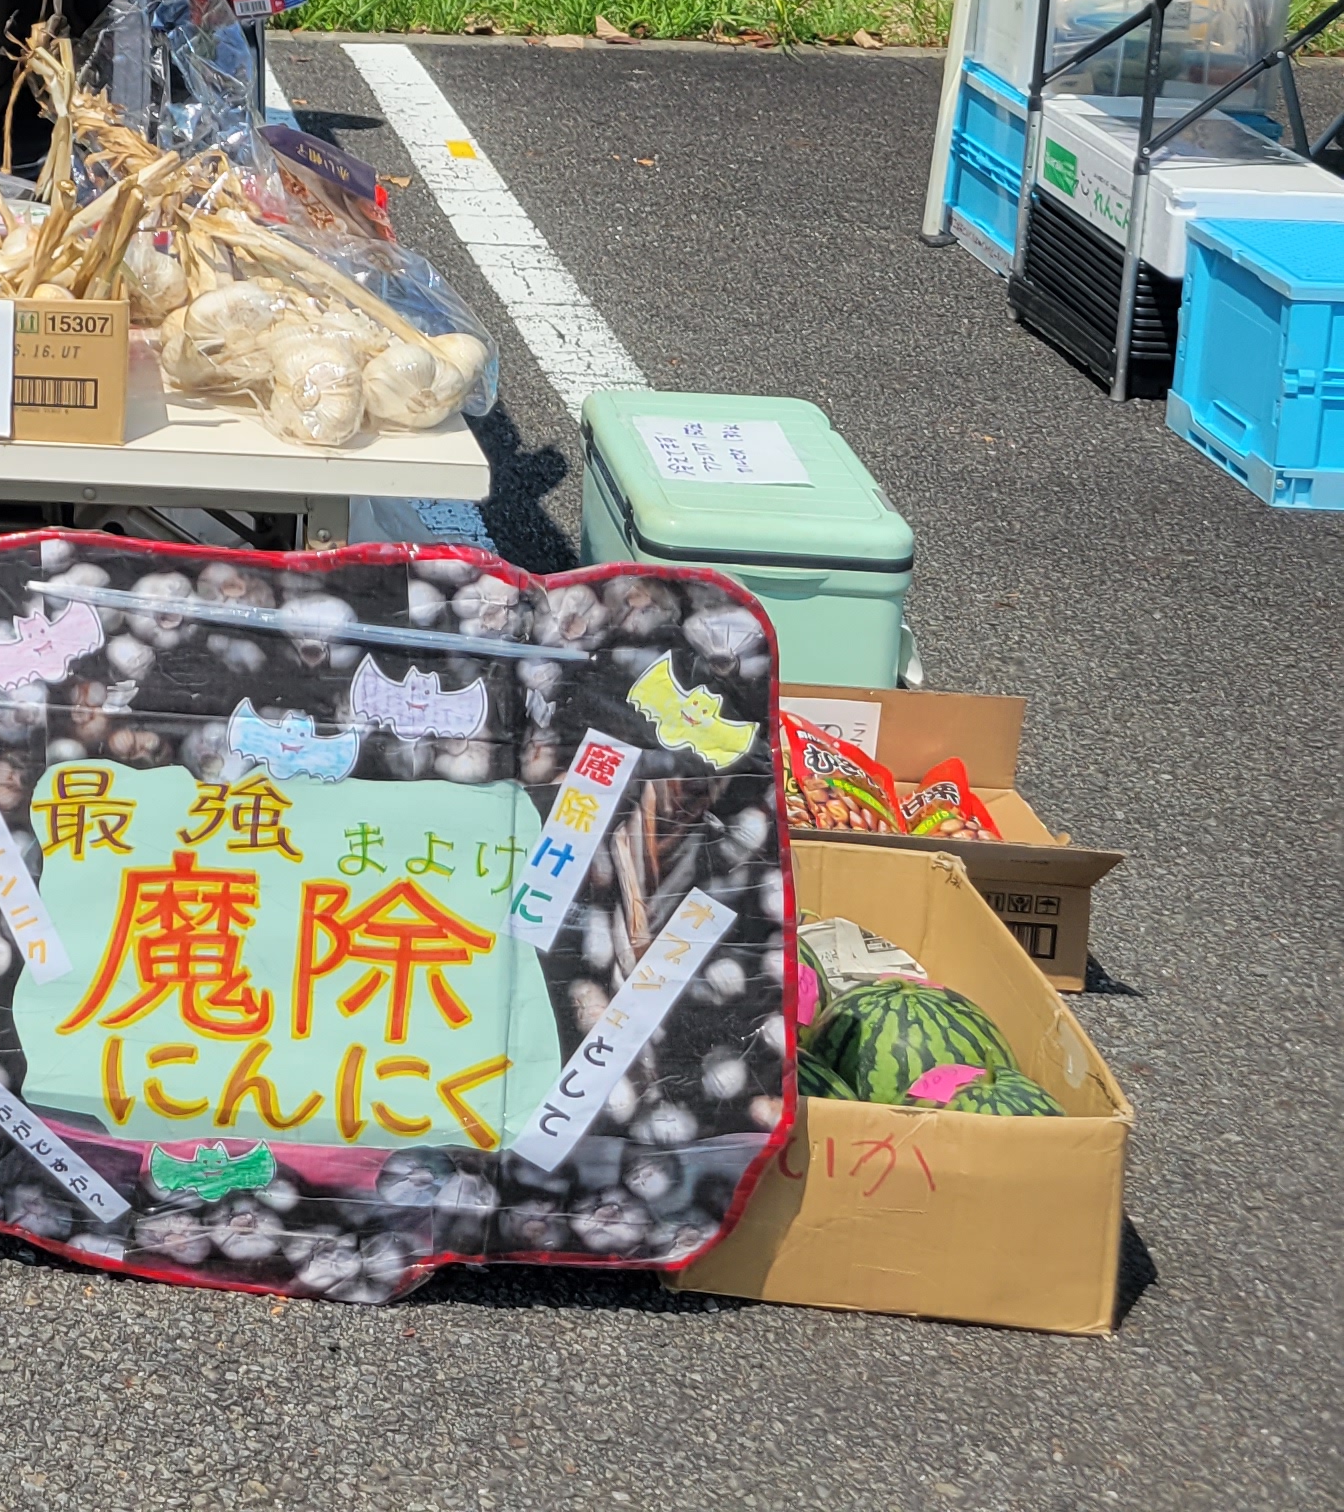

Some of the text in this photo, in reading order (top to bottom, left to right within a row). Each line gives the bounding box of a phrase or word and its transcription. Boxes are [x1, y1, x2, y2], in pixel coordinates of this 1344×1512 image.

[47, 313, 110, 334] 15307
[30, 765, 305, 862] 最強
[511, 740, 627, 925] 魔除けに
[55, 849, 496, 1045] 魔除
[538, 897, 716, 1138] オブジェとして
[100, 1035, 516, 1152] にんにく
[777, 1133, 937, 1198] いか
